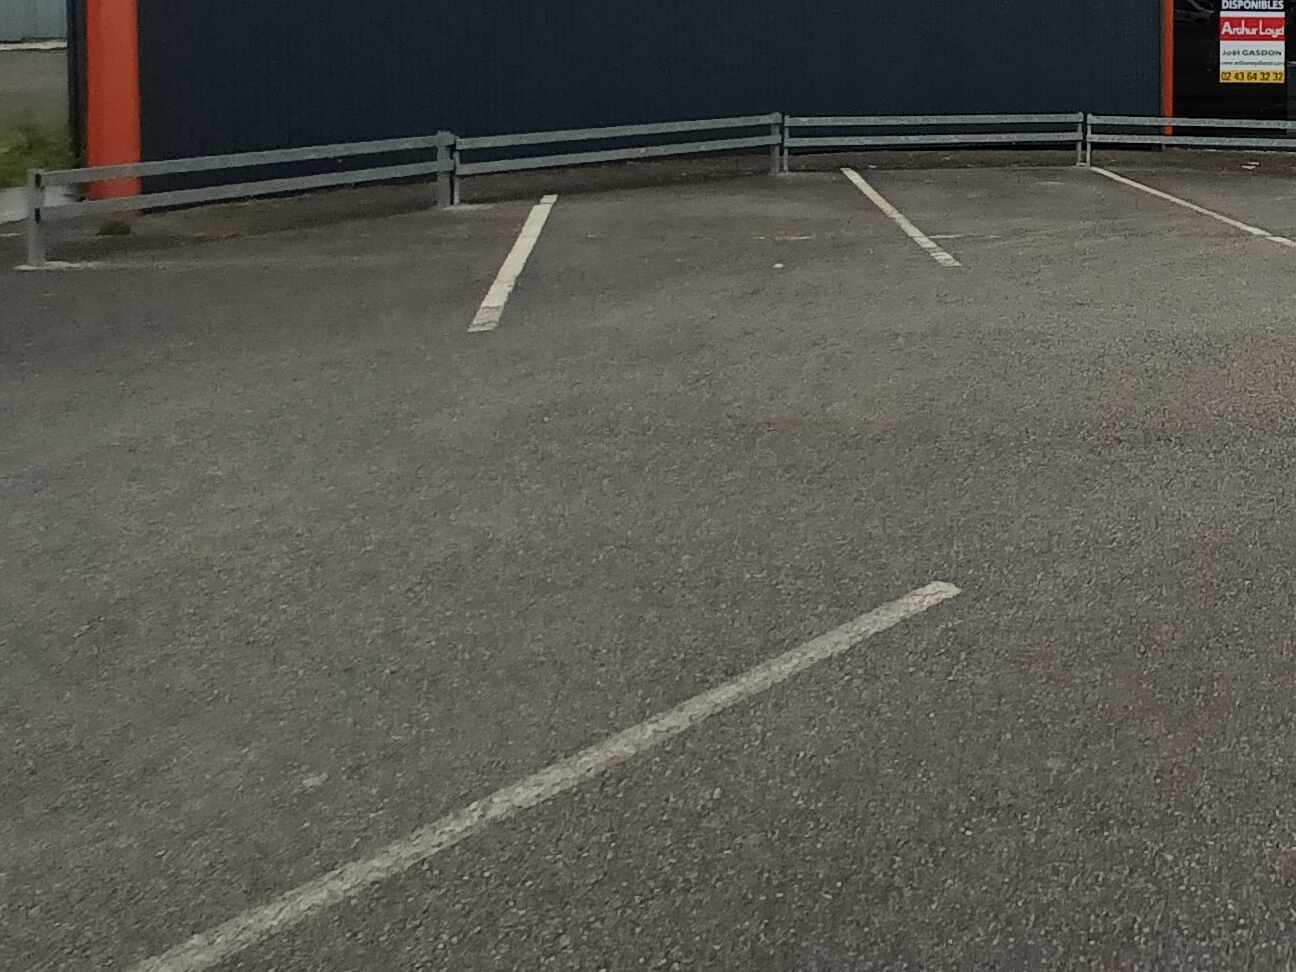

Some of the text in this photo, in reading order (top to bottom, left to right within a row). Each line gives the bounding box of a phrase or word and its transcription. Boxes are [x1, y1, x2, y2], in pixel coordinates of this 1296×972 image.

[1221, 0, 1285, 10] DISPONIBLES
[1259, 19, 1285, 39] Loyd
[1221, 71, 1284, 81] 02 43 64 32 32
